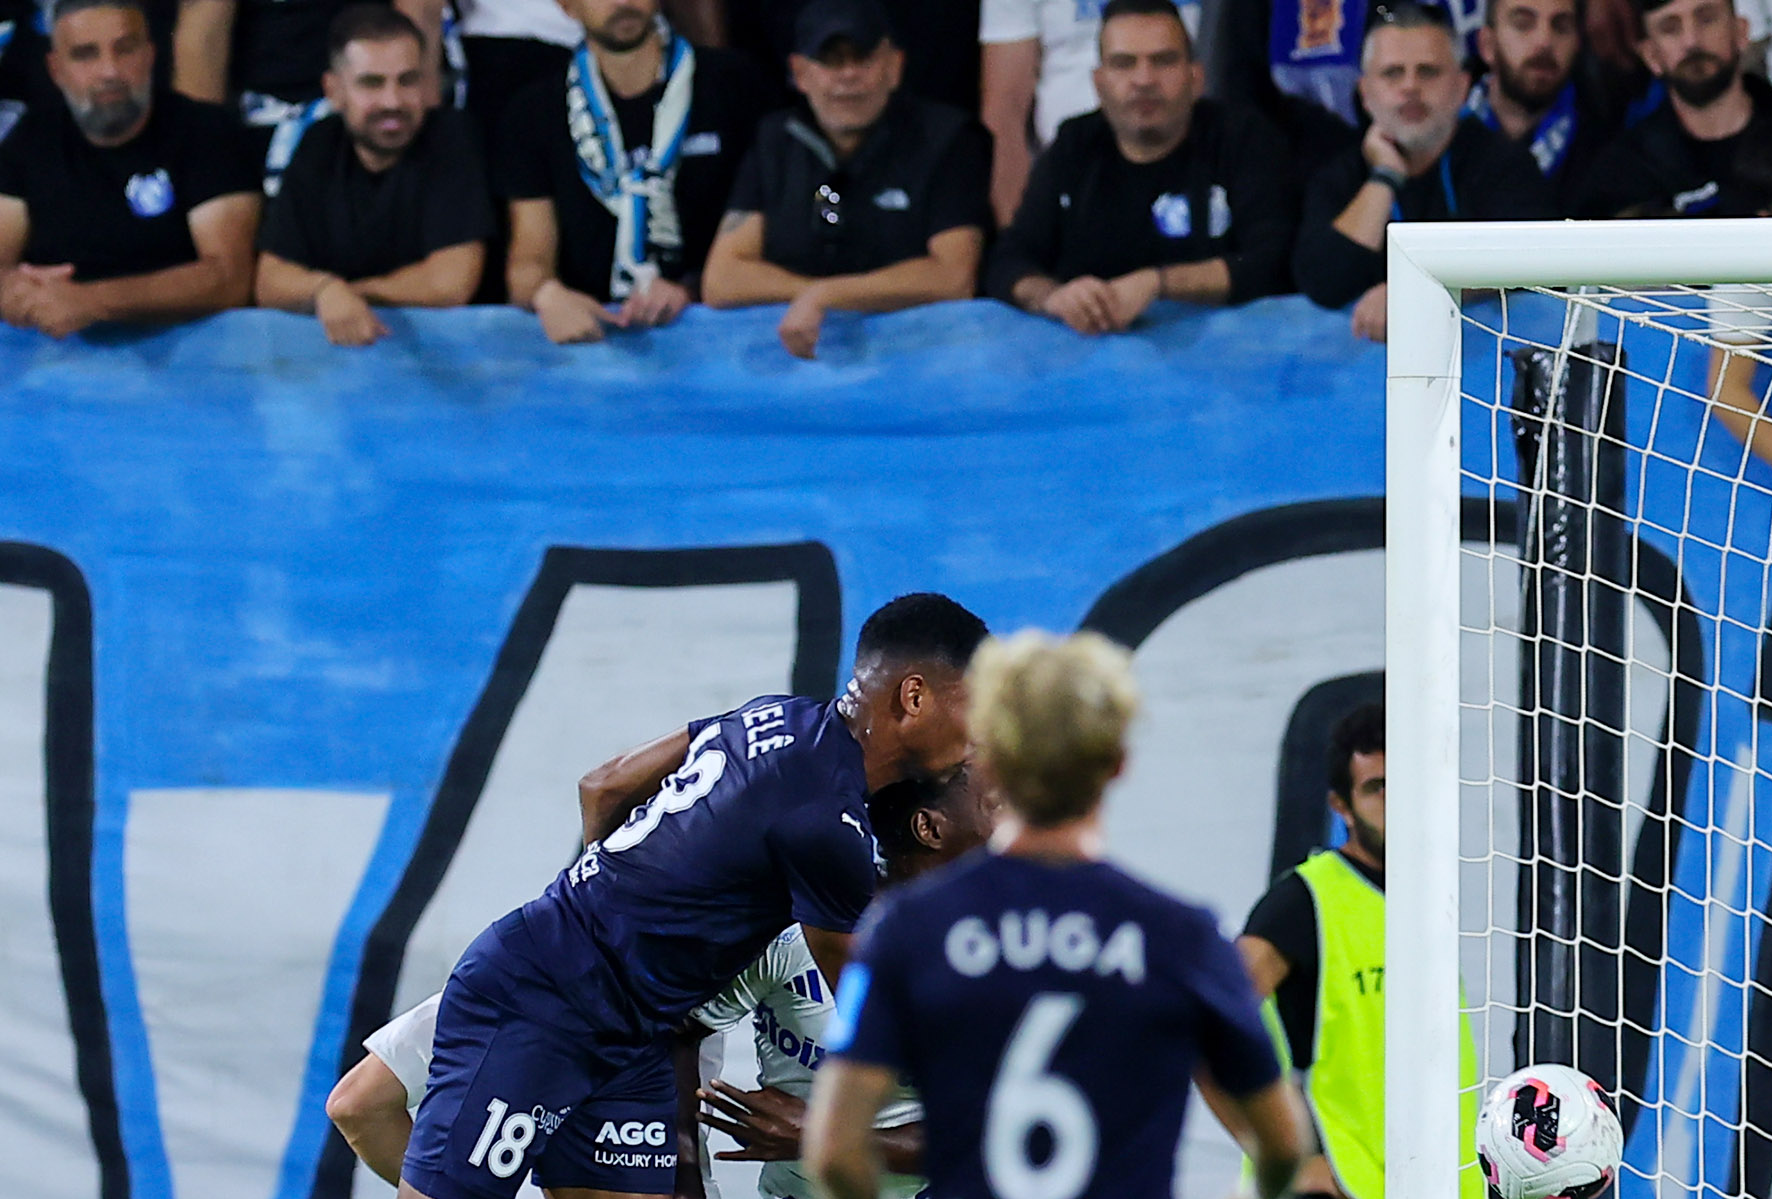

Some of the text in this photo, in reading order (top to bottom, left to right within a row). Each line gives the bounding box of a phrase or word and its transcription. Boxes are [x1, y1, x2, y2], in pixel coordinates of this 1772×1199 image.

[741, 701, 795, 760] ELÊ
[945, 908, 1147, 985] GUGA
[468, 1097, 536, 1178] 18
[595, 1121, 666, 1146] AGG
[595, 1150, 651, 1168] LUXURY
